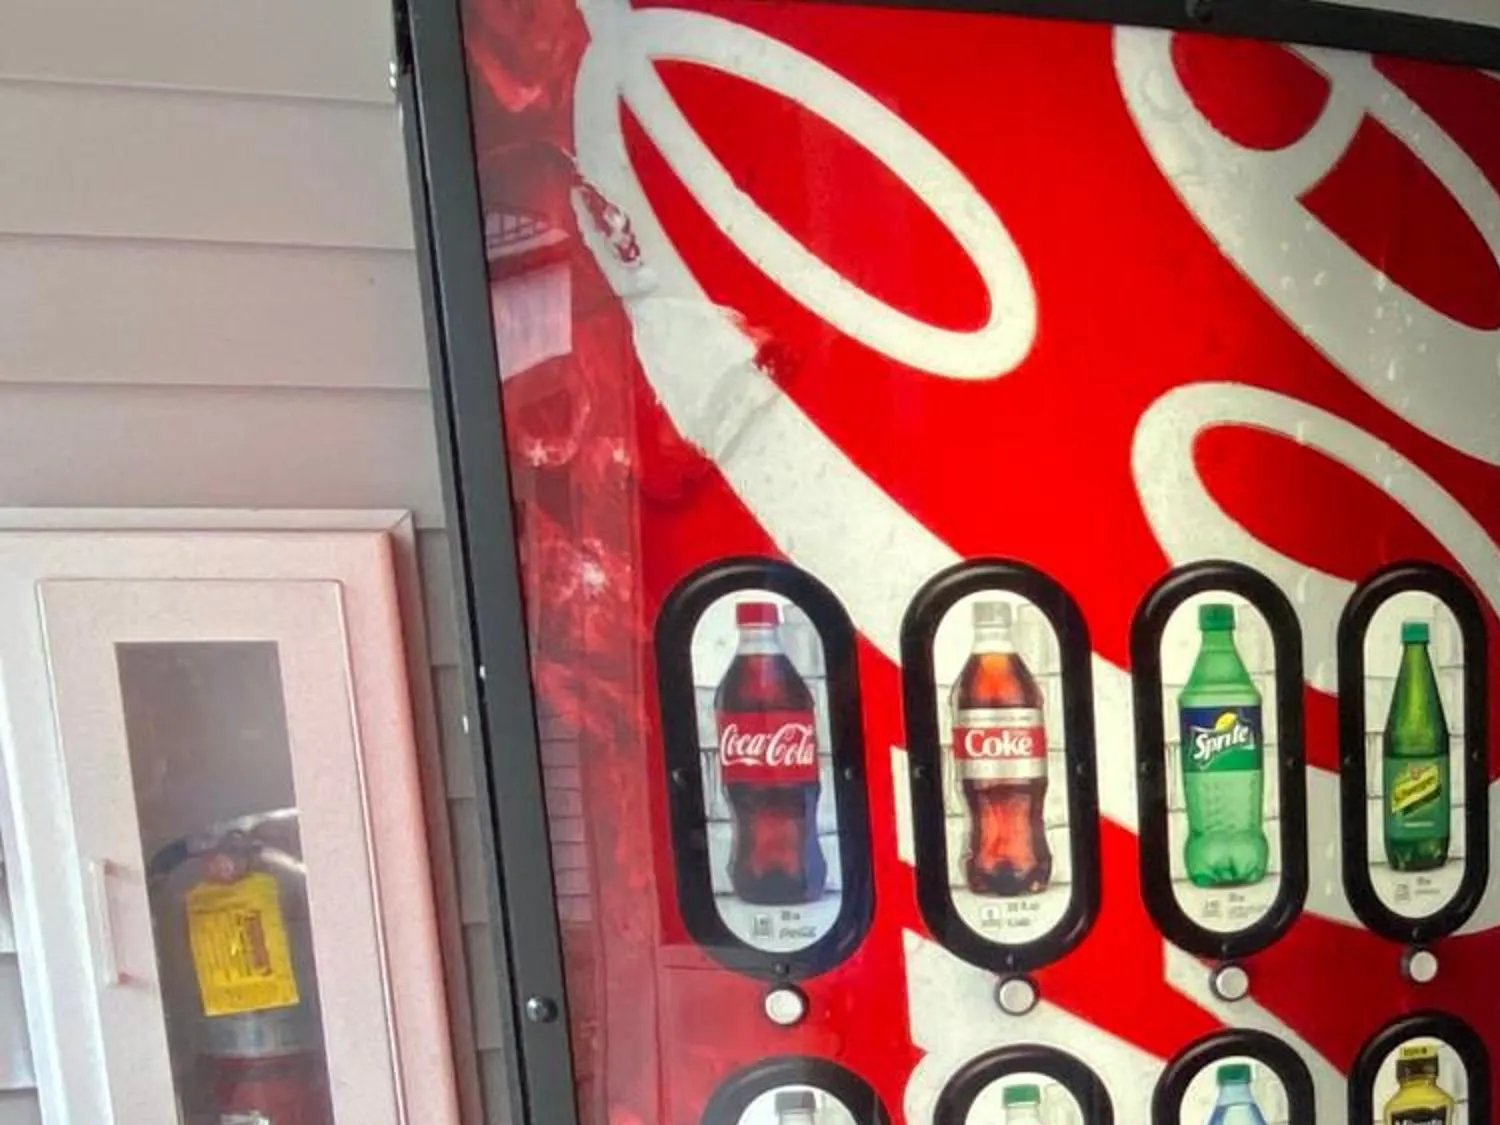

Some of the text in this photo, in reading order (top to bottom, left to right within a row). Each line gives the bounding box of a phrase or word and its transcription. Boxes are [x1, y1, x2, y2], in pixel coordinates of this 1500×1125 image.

[720, 722, 815, 767] Coca-Cola
[964, 729, 1033, 758] Coke
[1193, 726, 1250, 761] Sprite
